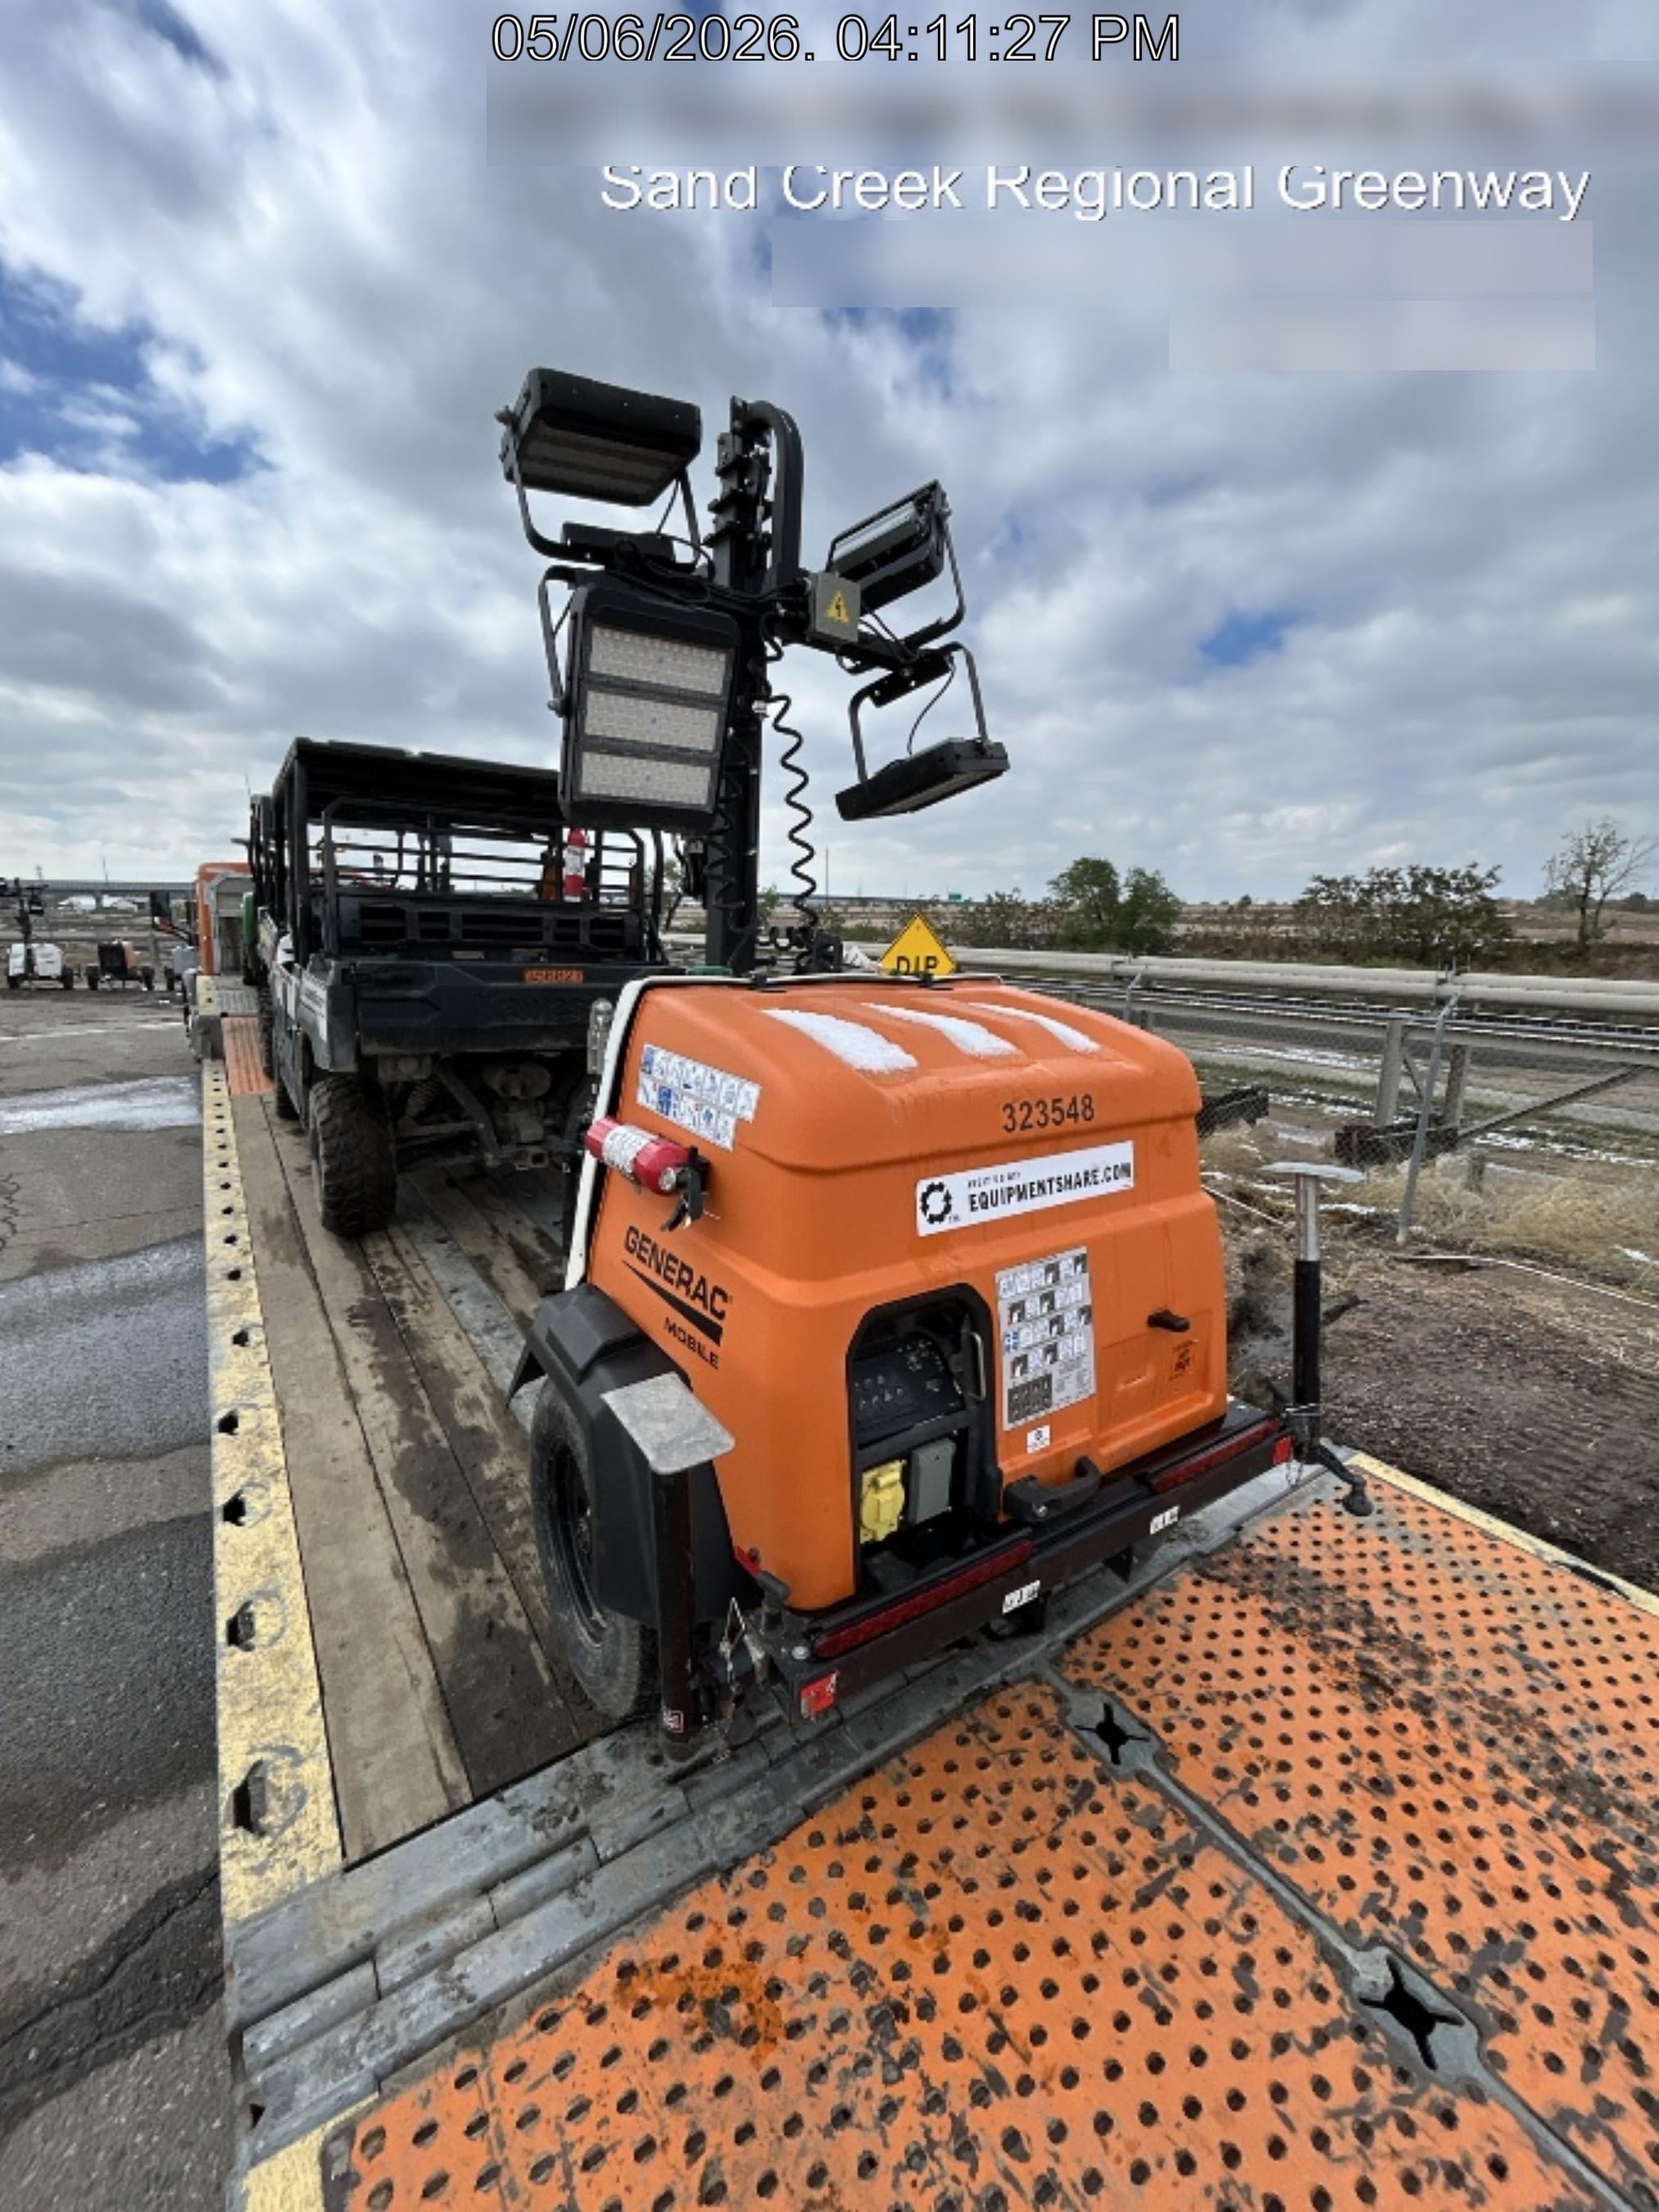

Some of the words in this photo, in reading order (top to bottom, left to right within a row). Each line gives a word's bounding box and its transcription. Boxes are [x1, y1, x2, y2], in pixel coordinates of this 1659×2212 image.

[896, 955, 939, 974] DIP
[1002, 1093, 1095, 1134] 323548
[624, 1226, 730, 1321] GENERAC
[662, 1316, 719, 1370] MOBILE
